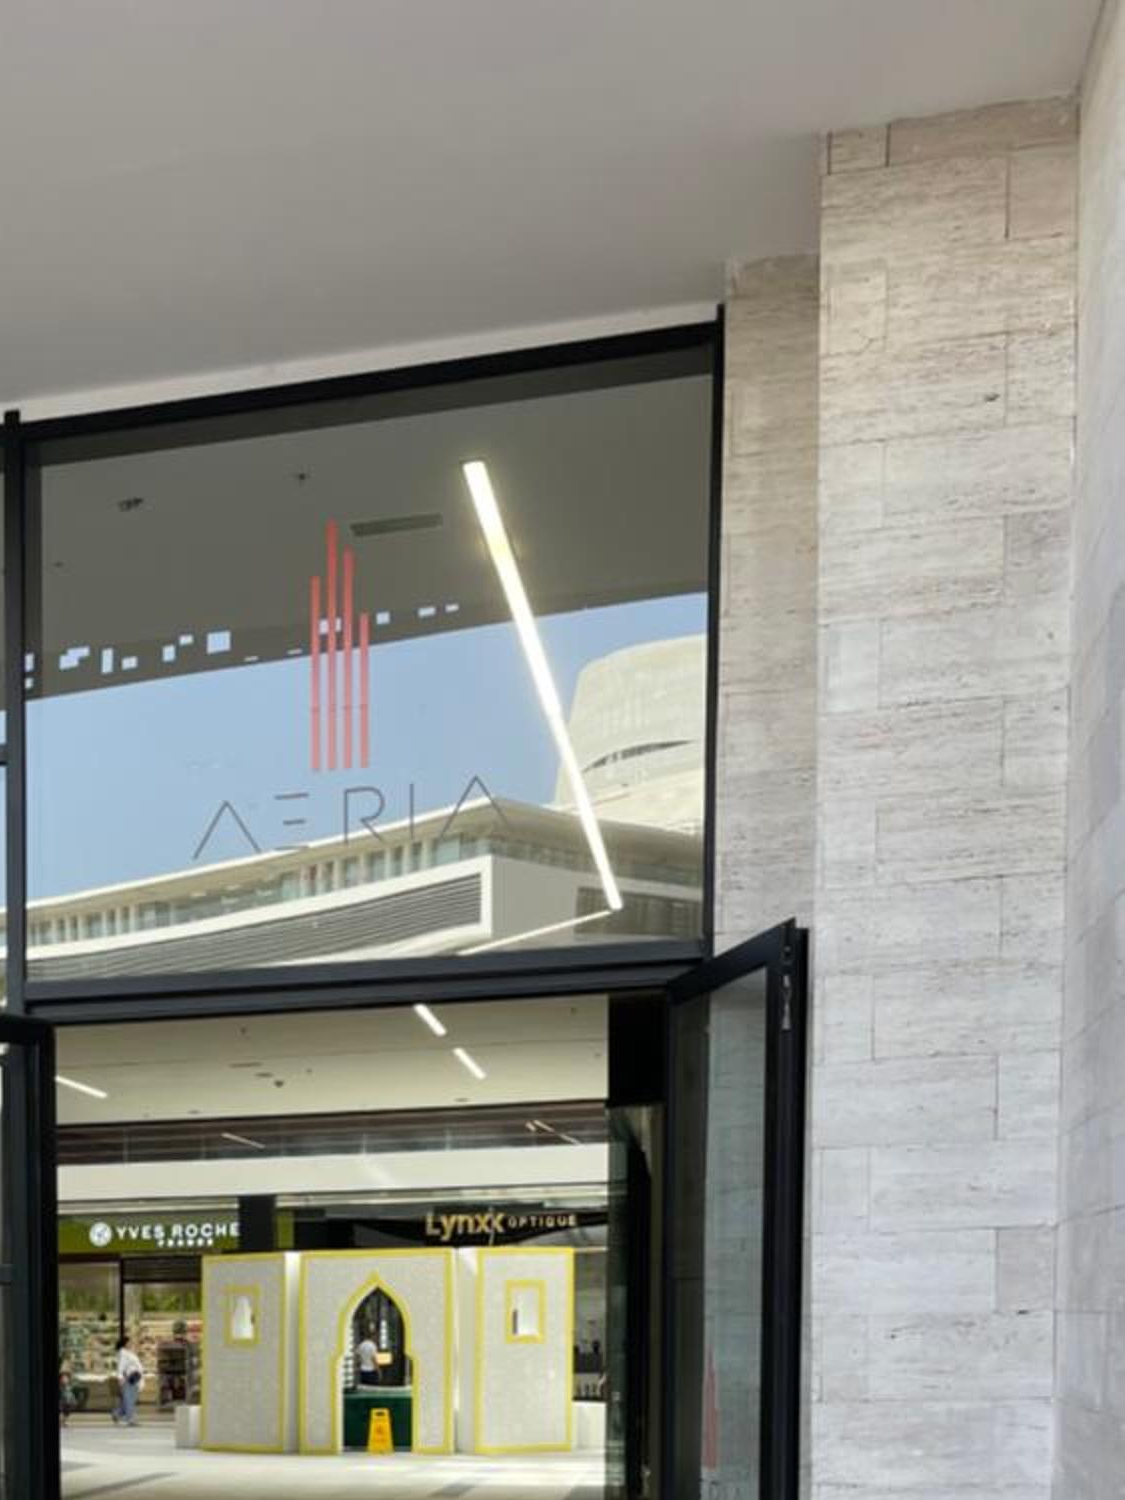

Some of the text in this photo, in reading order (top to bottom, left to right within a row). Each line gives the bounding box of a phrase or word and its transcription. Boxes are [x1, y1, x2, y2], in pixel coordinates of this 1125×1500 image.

[192, 773, 512, 861] AERIA
[507, 1215, 576, 1228] OPTIQUE
[116, 1224, 165, 1239] YVES
